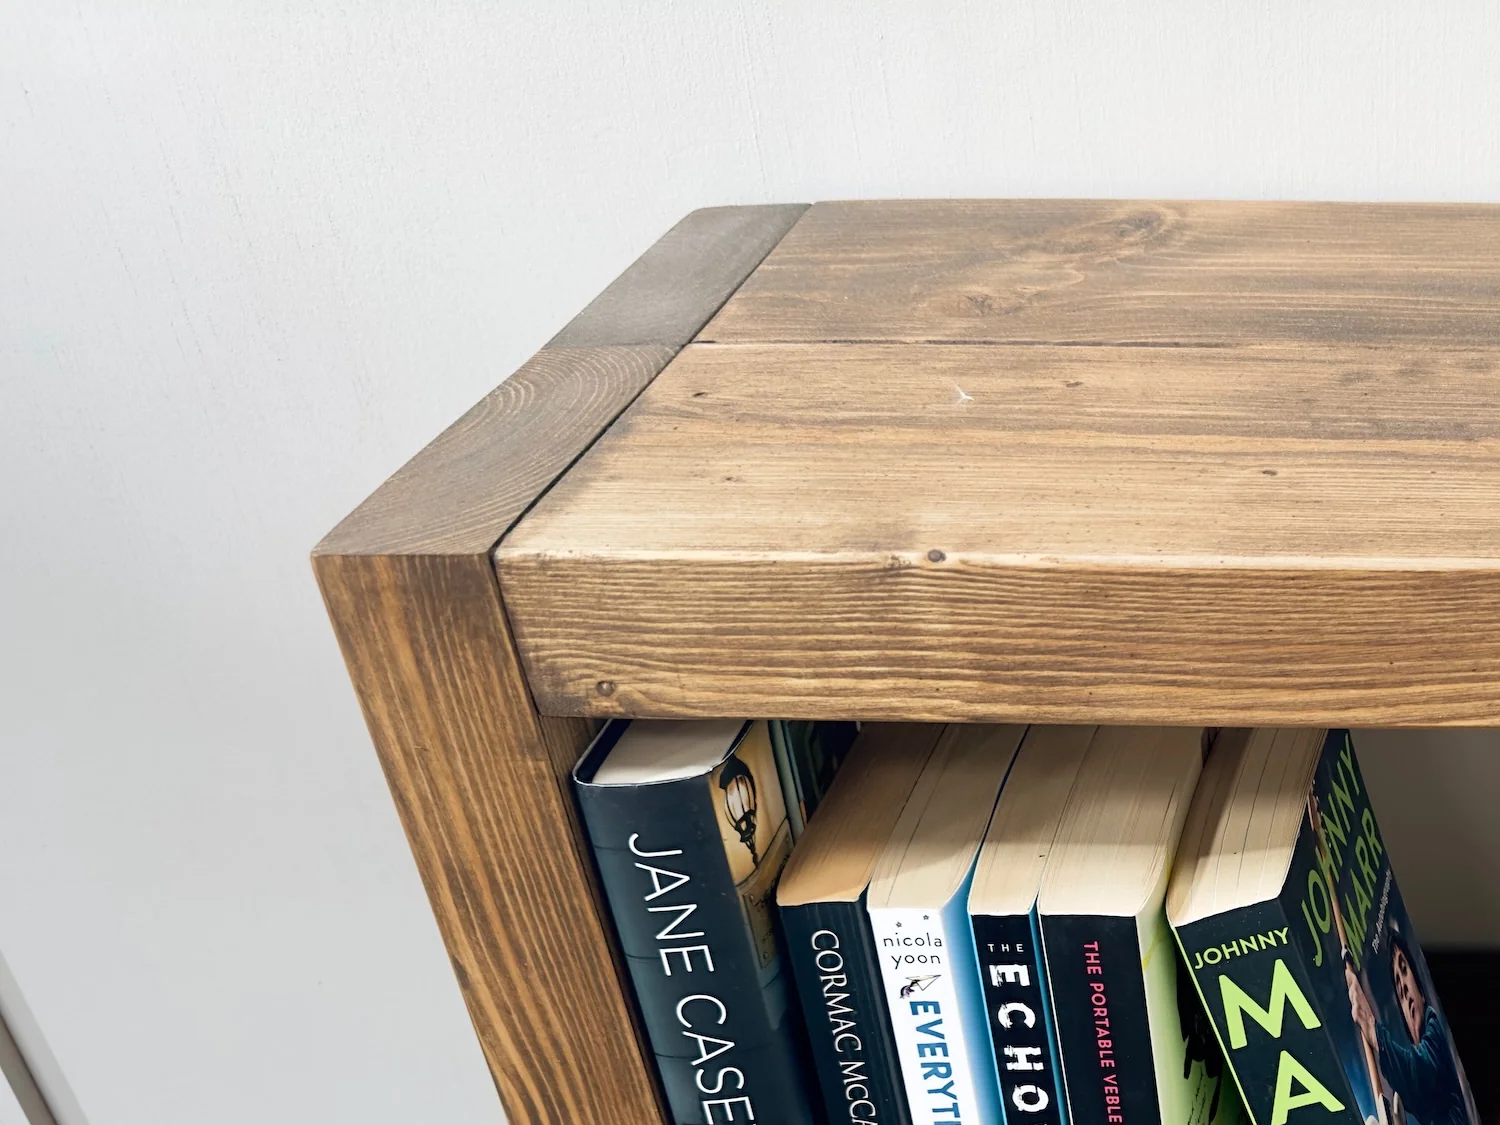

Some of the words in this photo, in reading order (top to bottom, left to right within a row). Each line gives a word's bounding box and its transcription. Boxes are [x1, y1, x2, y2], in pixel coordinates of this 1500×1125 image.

[1301, 733, 1359, 967] JOHNNY
[1341, 807, 1382, 972] MARR
[628, 833, 715, 976] JANE
[883, 933, 943, 948] nicola
[810, 929, 862, 1052] CORMAC
[891, 953, 941, 970] yoon
[987, 943, 1025, 953] THE
[1084, 941, 1102, 975] THE
[1194, 927, 1290, 970] JOHNNY
[989, 964, 1049, 1113] ECHO
[1089, 982, 1115, 1068] PORTABLE
